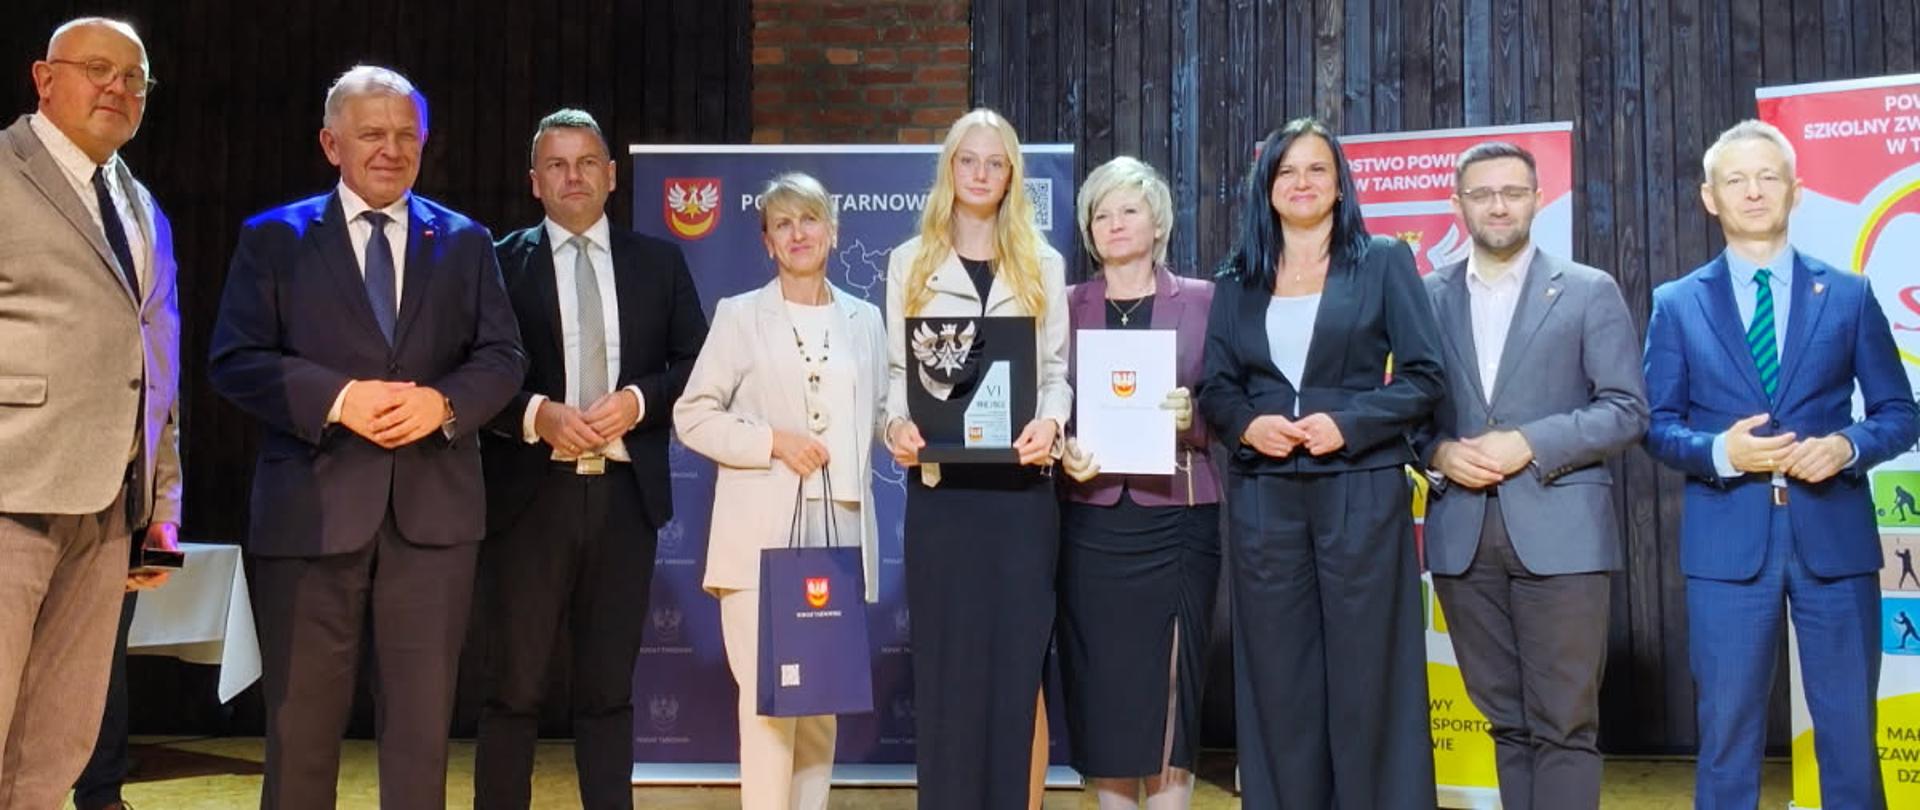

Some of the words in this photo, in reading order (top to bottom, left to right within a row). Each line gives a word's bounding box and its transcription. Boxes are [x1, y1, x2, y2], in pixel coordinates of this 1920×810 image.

[1804, 118, 1890, 140] SZKOLNY
[1886, 138, 1907, 155] W
[1887, 727, 1920, 742] MA
